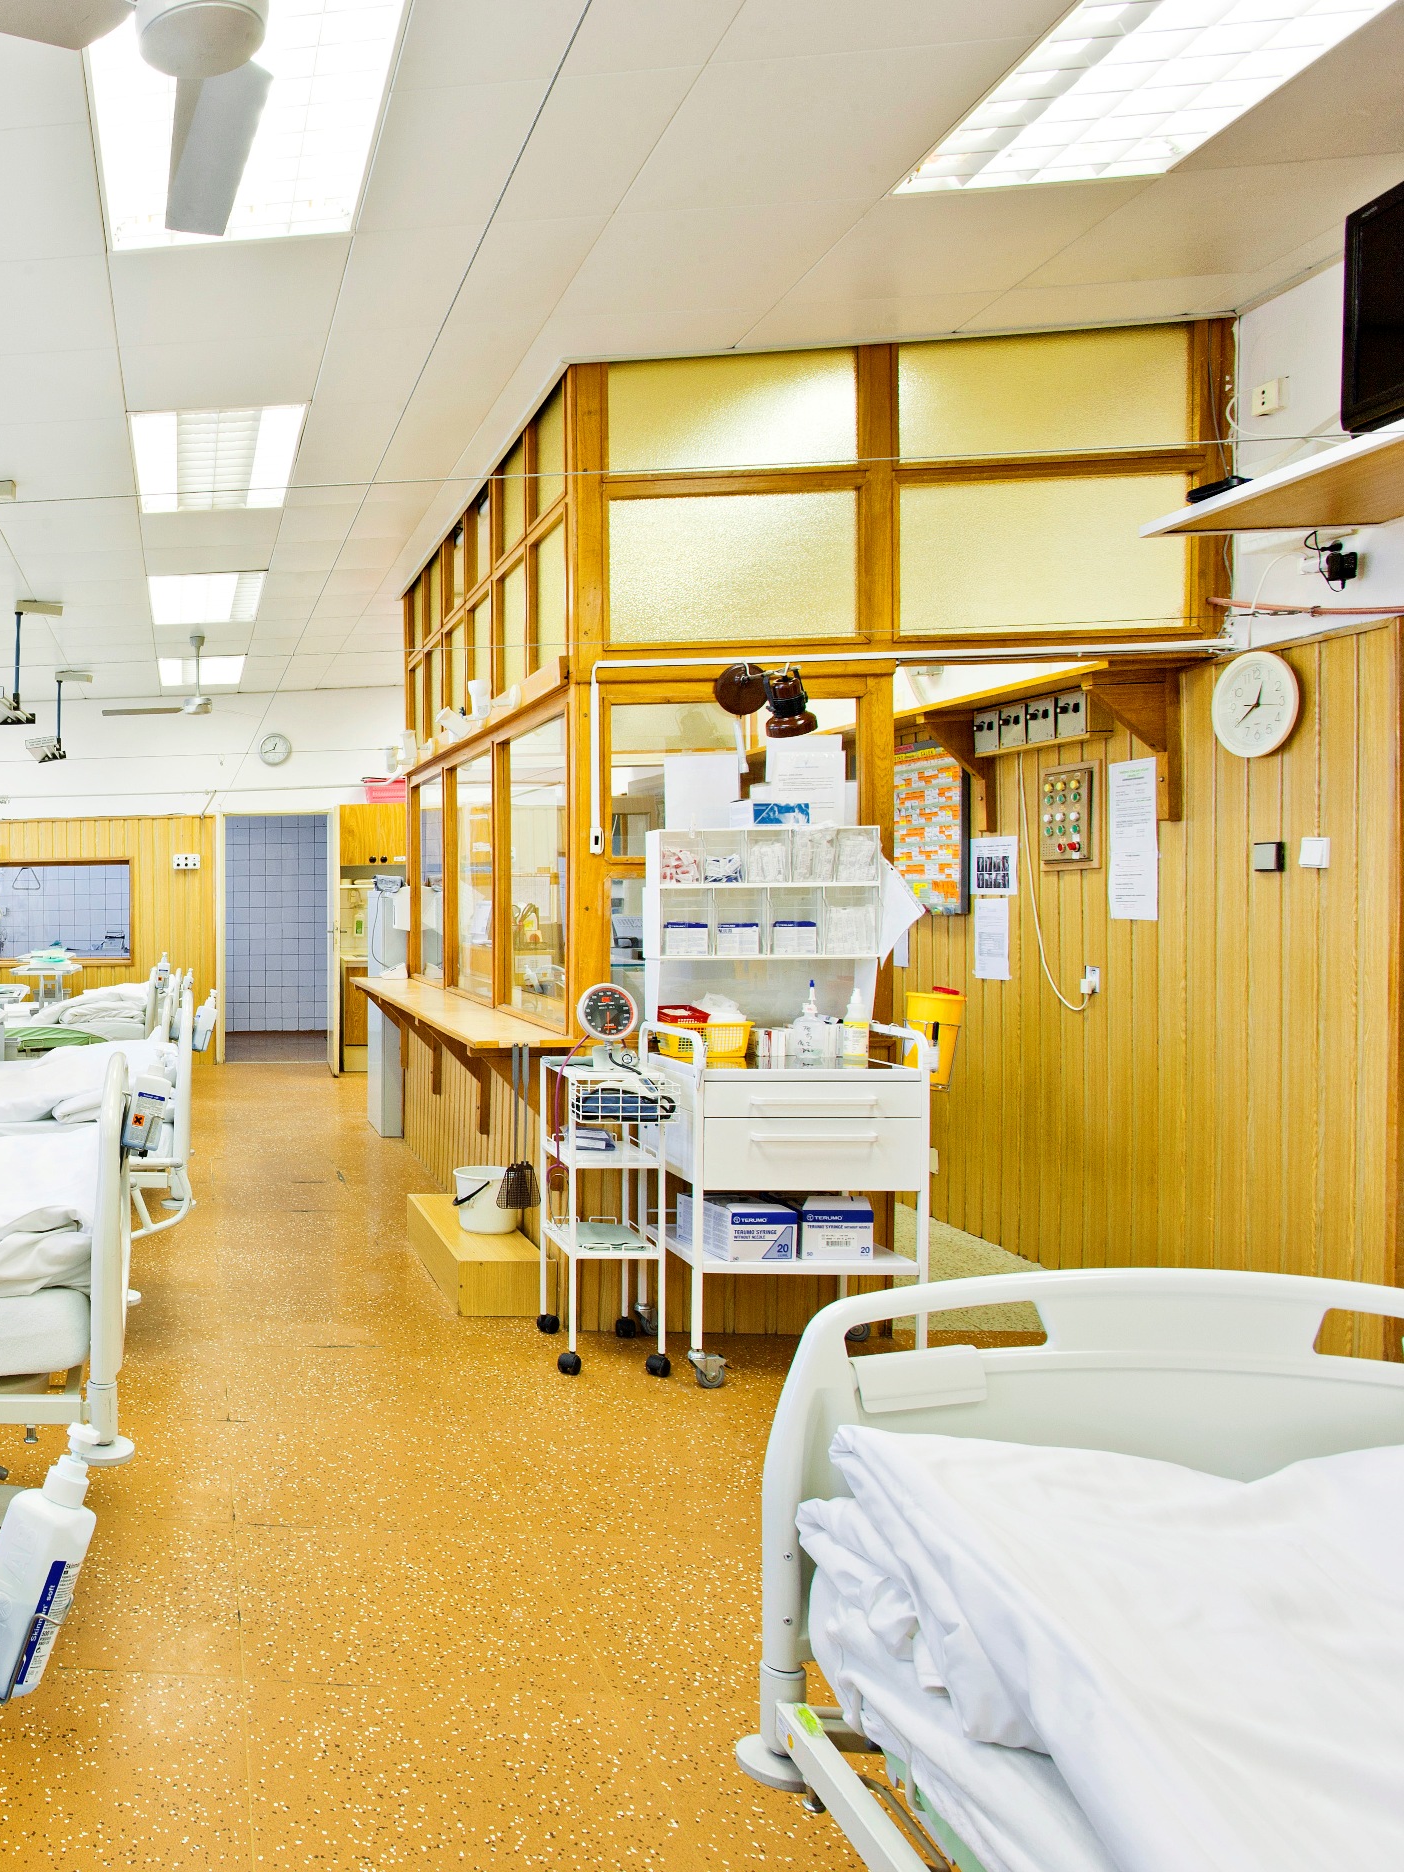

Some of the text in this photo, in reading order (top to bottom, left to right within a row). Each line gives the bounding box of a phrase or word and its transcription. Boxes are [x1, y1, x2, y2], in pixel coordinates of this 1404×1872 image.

[1242, 673, 1251, 685] 11
[1252, 667, 1261, 680] 12
[1275, 680, 1281, 691] 2
[1278, 696, 1285, 706] 3
[1243, 726, 1250, 737] 7
[1254, 729, 1260, 740] 6
[1265, 724, 1272, 734] 5
[777, 1243, 789, 1253] 20
[860, 1246, 871, 1254] 20
[46, 1584, 56, 1601] soft
